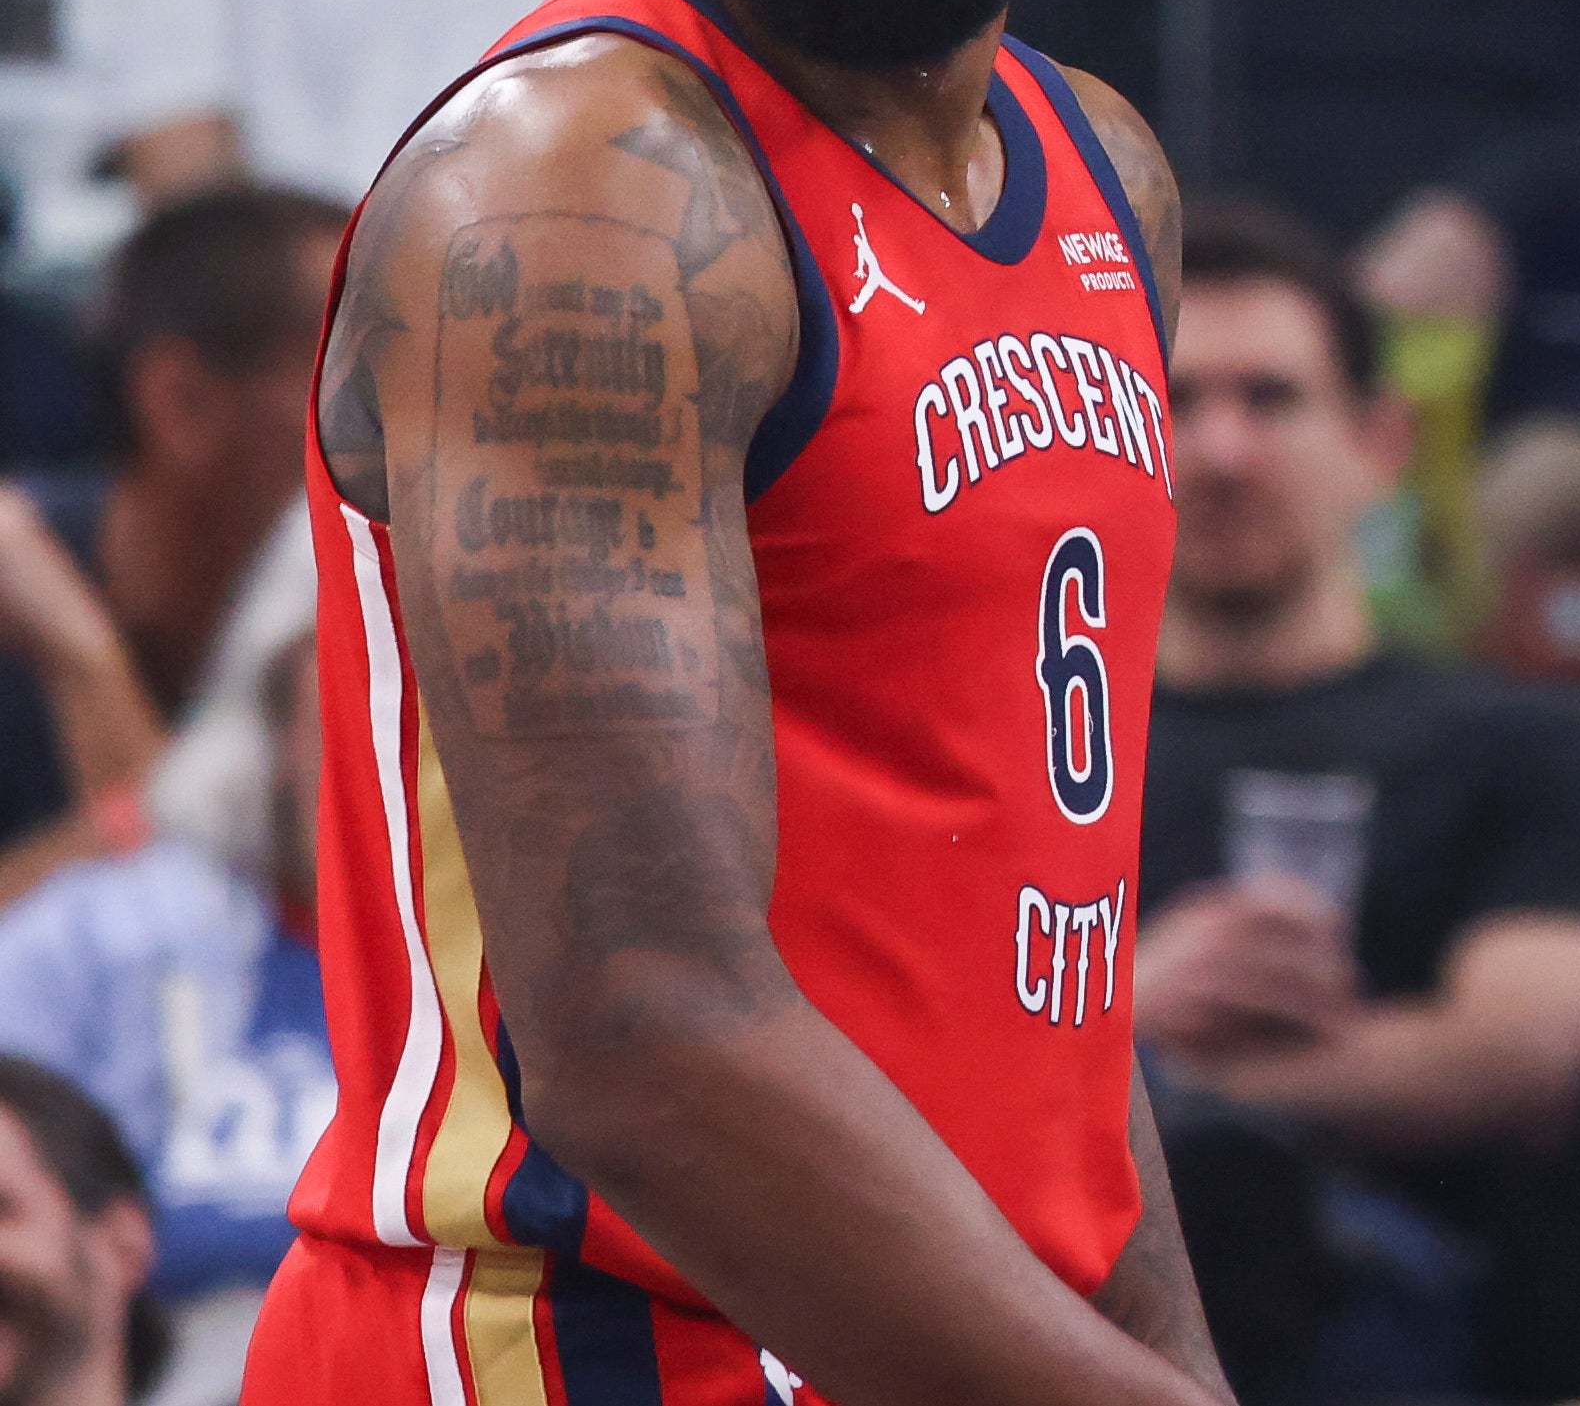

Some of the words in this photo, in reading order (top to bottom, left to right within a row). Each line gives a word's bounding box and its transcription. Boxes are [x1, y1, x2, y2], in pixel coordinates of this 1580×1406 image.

[1057, 230, 1129, 266] NEWAGE
[914, 332, 1174, 513] CRESCENT
[1035, 526, 1114, 825] 6
[1014, 876, 1127, 1028] CITY
